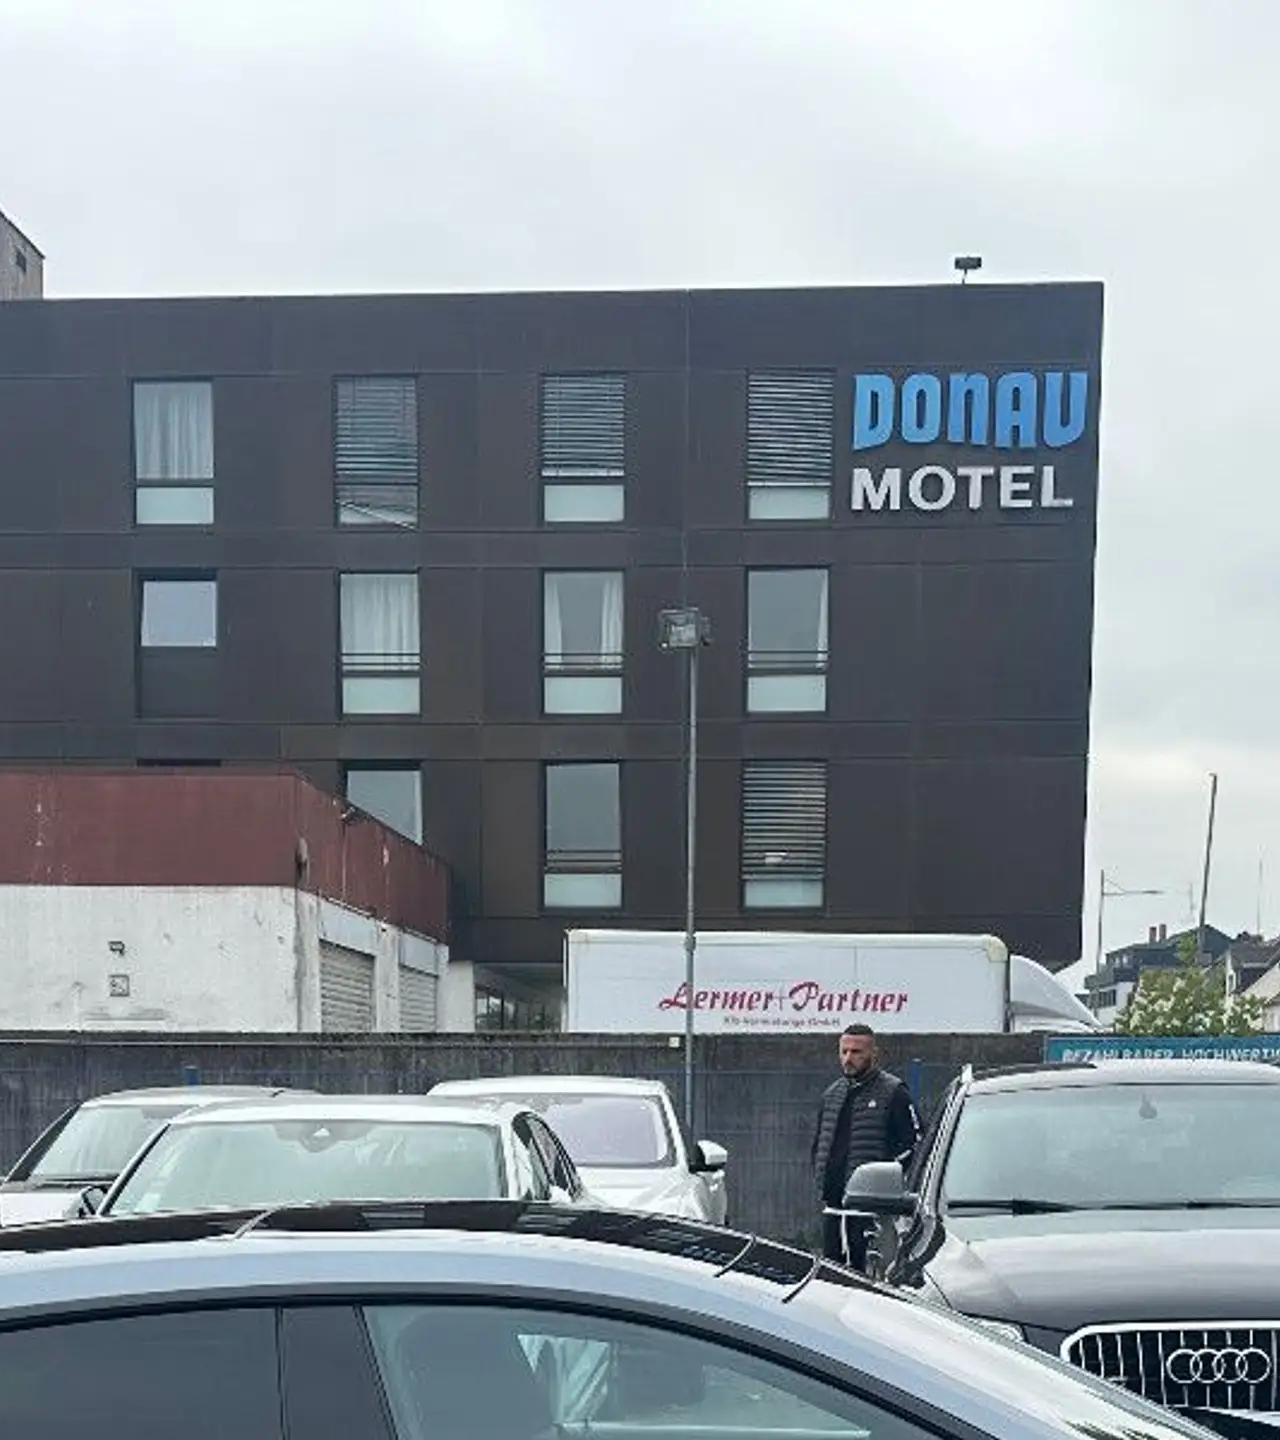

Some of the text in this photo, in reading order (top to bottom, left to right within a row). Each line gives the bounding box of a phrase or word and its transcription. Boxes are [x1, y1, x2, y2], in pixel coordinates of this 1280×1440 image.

[853, 371, 1088, 450] DONAU
[851, 465, 1074, 511] MOTEL
[789, 981, 908, 1012] Partner
